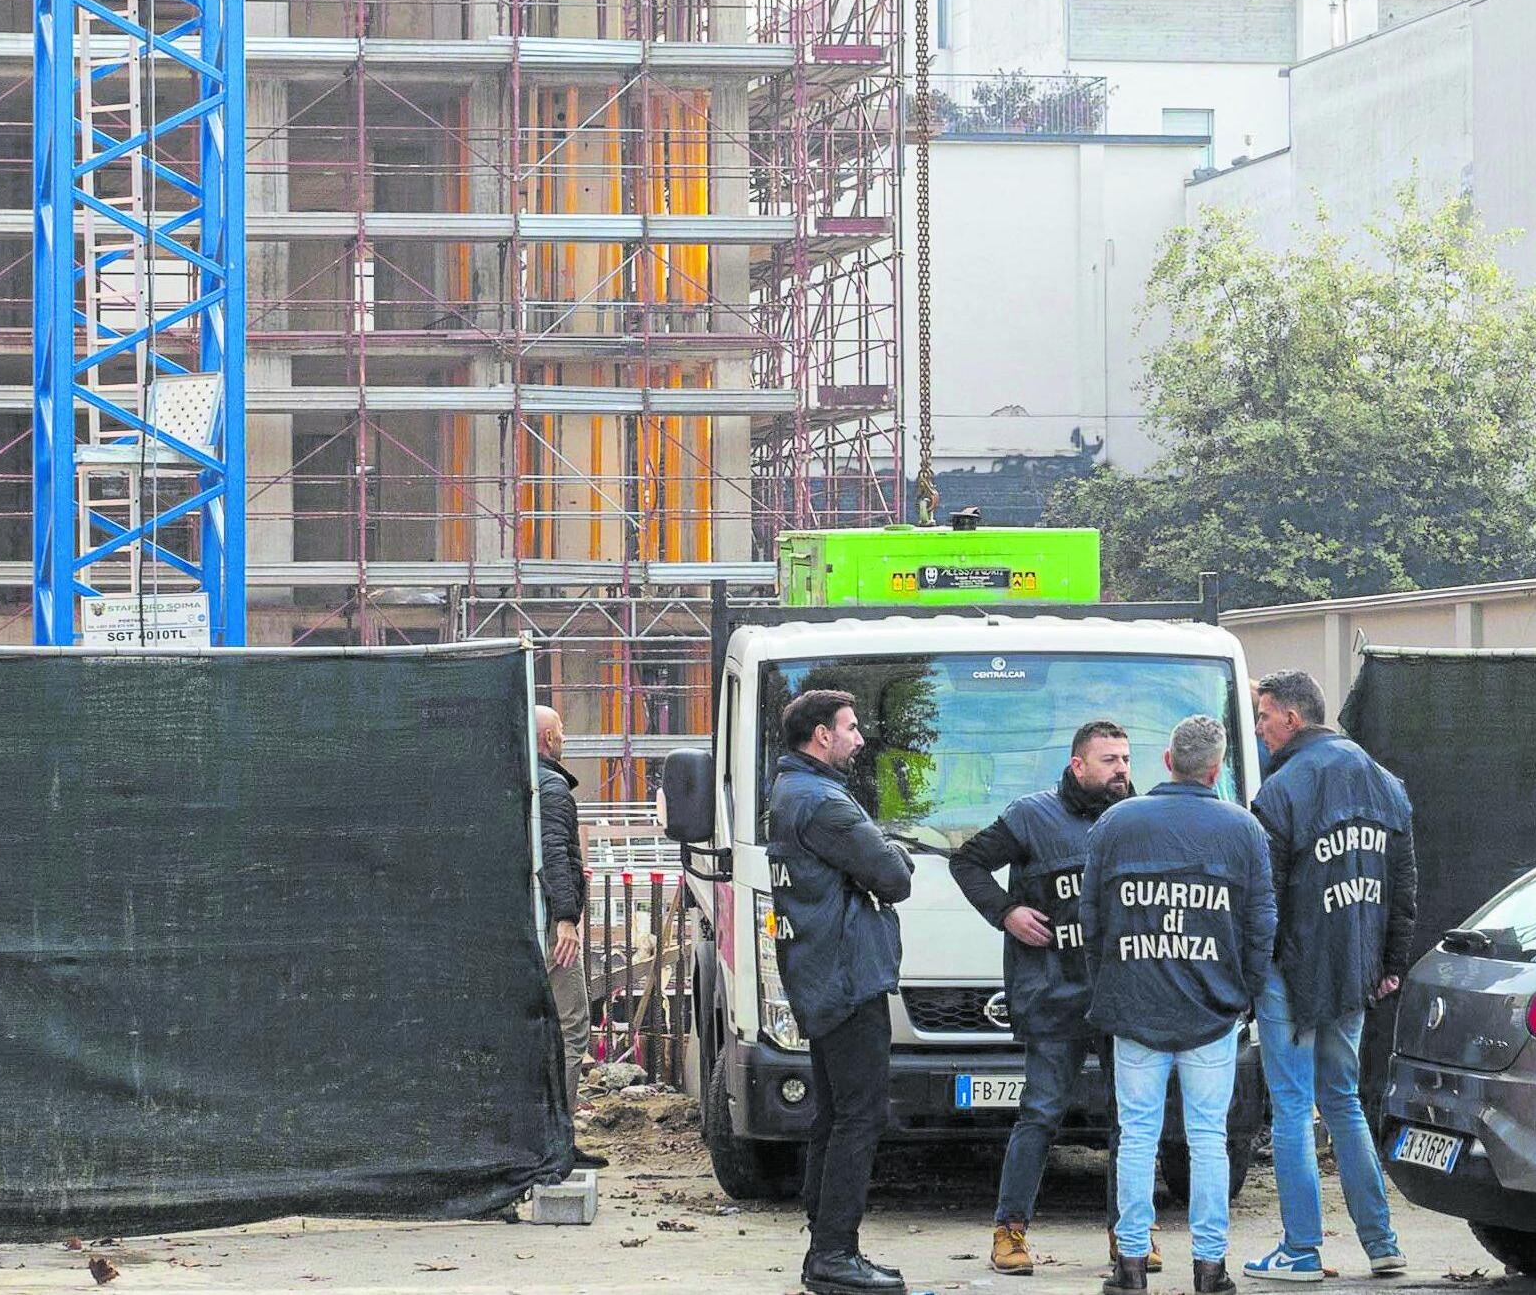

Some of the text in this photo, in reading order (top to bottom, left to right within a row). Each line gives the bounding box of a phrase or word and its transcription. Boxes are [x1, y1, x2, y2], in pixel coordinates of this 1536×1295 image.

[107, 632, 134, 642] SGT
[972, 671, 1026, 679] CENTRALCAR
[1120, 881, 1230, 911] GUARDIA
[1163, 909, 1184, 933] di
[1119, 934, 1219, 961] FINANZA
[973, 1081, 993, 1100] FB
